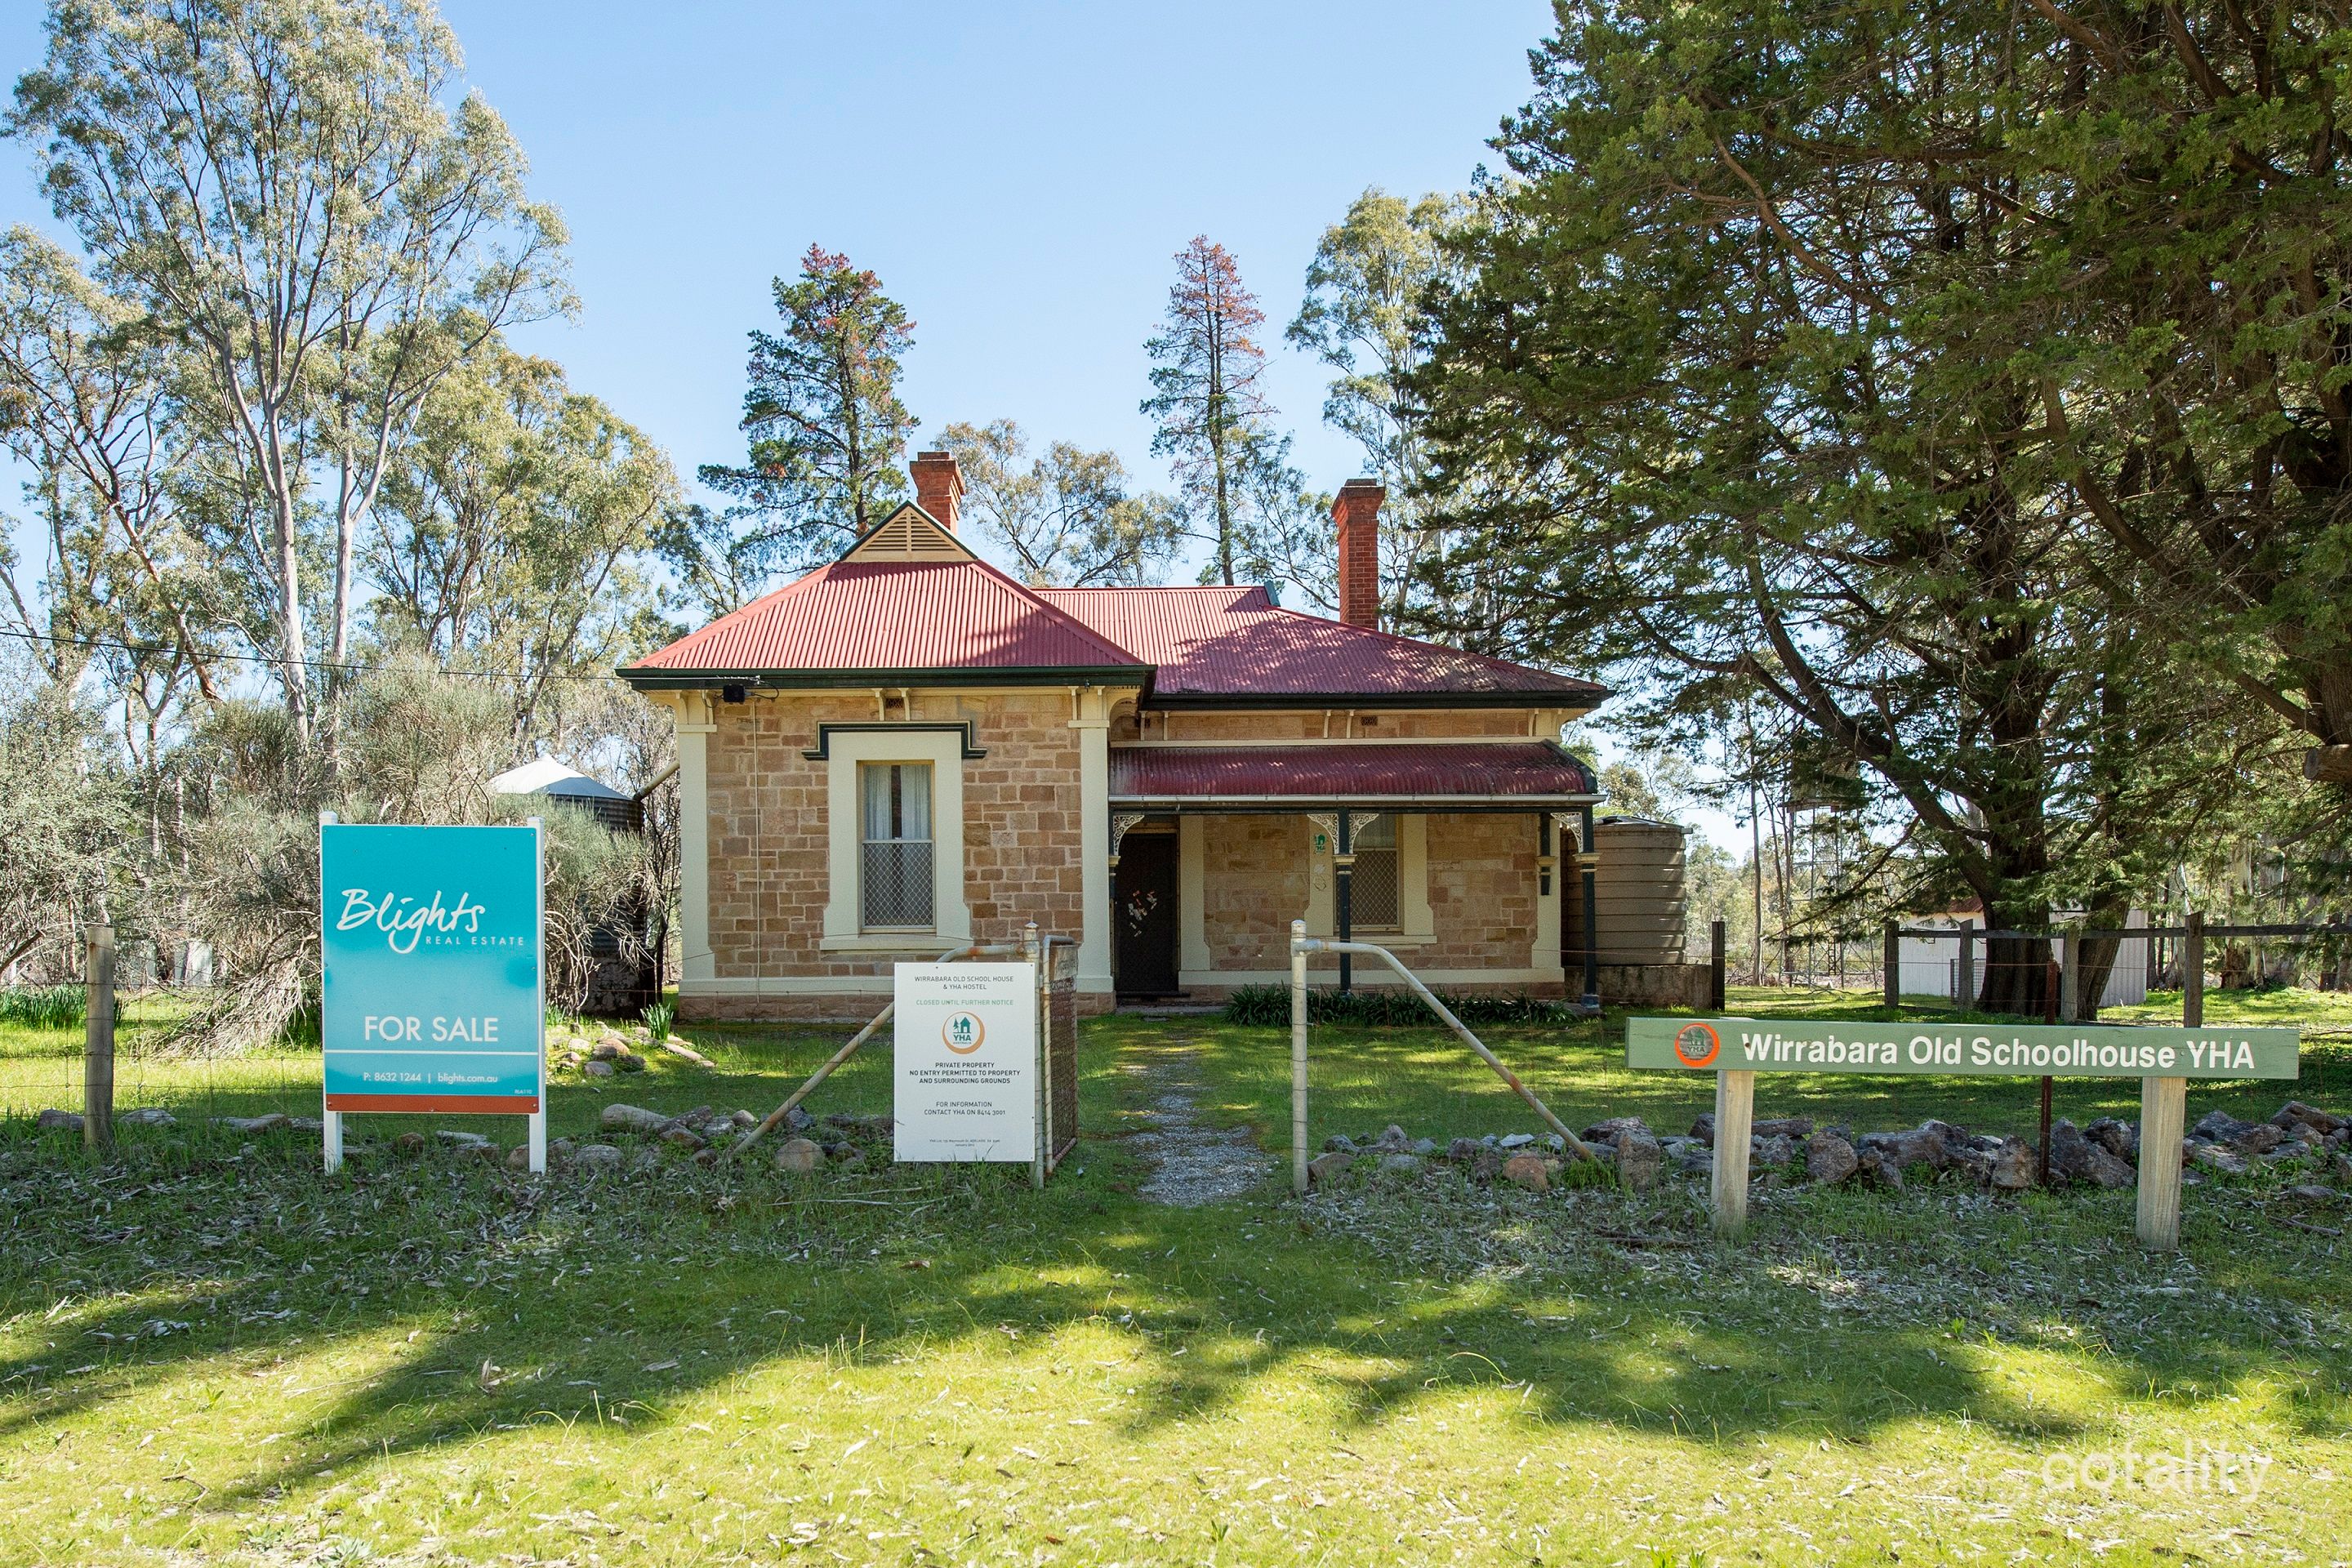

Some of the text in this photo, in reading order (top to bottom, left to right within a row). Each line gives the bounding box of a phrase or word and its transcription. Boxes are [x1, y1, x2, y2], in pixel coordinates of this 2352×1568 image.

[336, 889, 486, 954] Blights
[425, 936, 523, 946] REAL ESTATE
[365, 1016, 499, 1042] FOR SALE
[1741, 1033, 2255, 1069] Wirrabara Old Schoolhouse YHA
[363, 1072, 498, 1084] P: 8632 1244 blights.com.au
